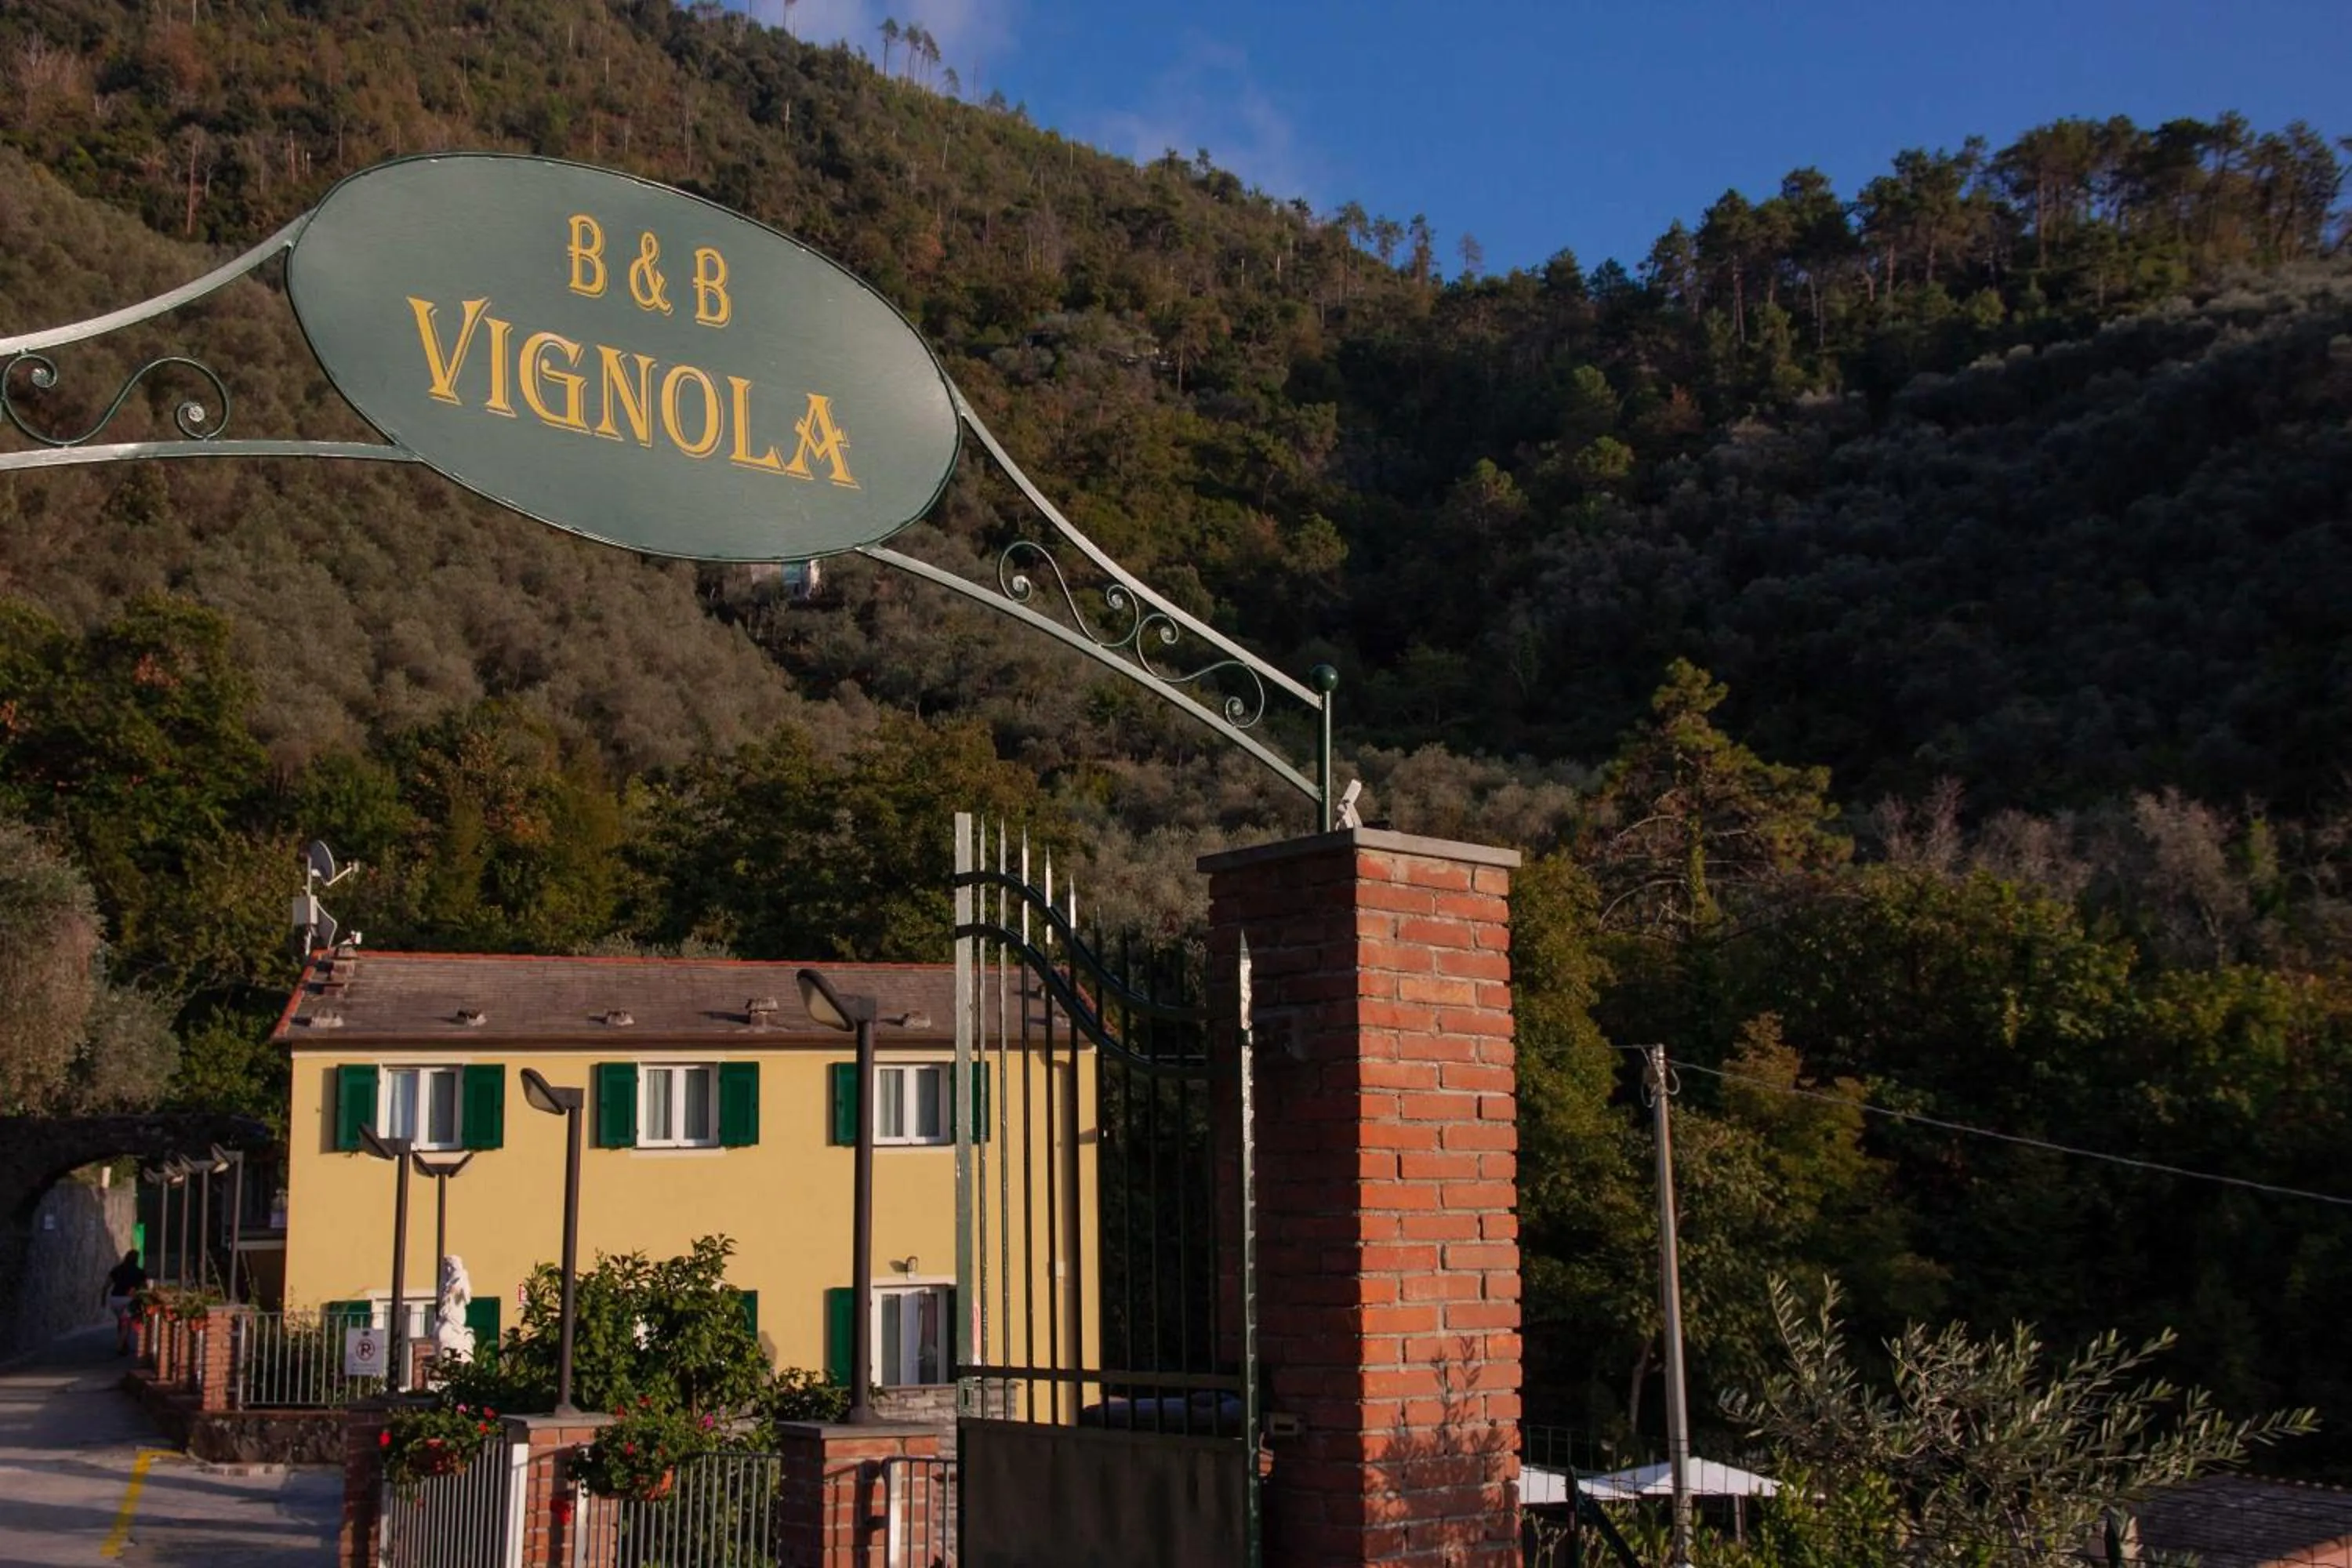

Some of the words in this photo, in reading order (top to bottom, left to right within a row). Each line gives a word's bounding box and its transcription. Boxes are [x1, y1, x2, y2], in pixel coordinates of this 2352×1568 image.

[567, 212, 608, 298] B
[628, 230, 673, 315] &
[692, 245, 732, 328] B
[406, 295, 861, 489] VIGNOLA
